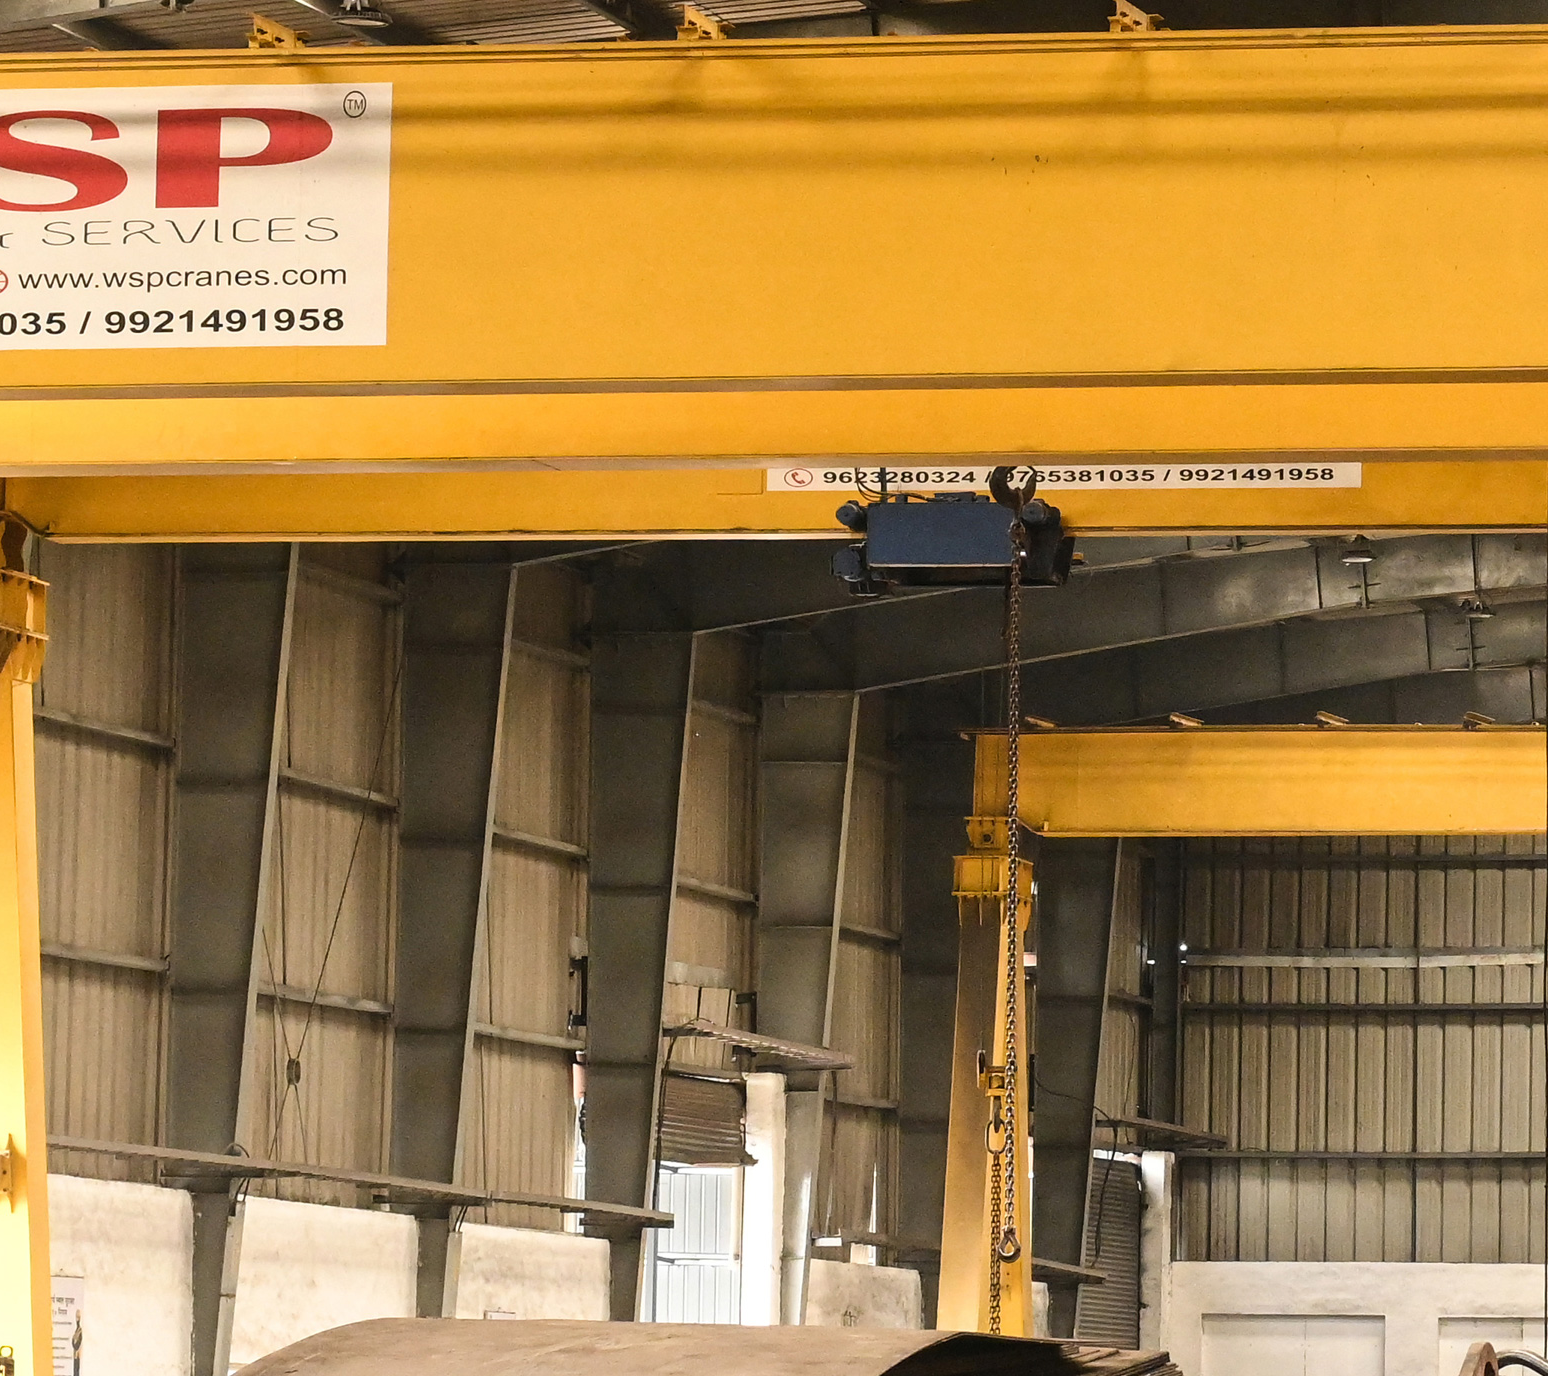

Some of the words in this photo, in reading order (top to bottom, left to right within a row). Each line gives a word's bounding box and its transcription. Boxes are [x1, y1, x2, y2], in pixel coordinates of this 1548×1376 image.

[42, 217, 339, 246] SERVICES
[18, 268, 347, 293] www.wspcranes.com
[79, 311, 92, 335] /
[104, 308, 345, 334] 9921491958
[1163, 469, 1171, 482] /
[1179, 468, 1334, 482] 9921491958
